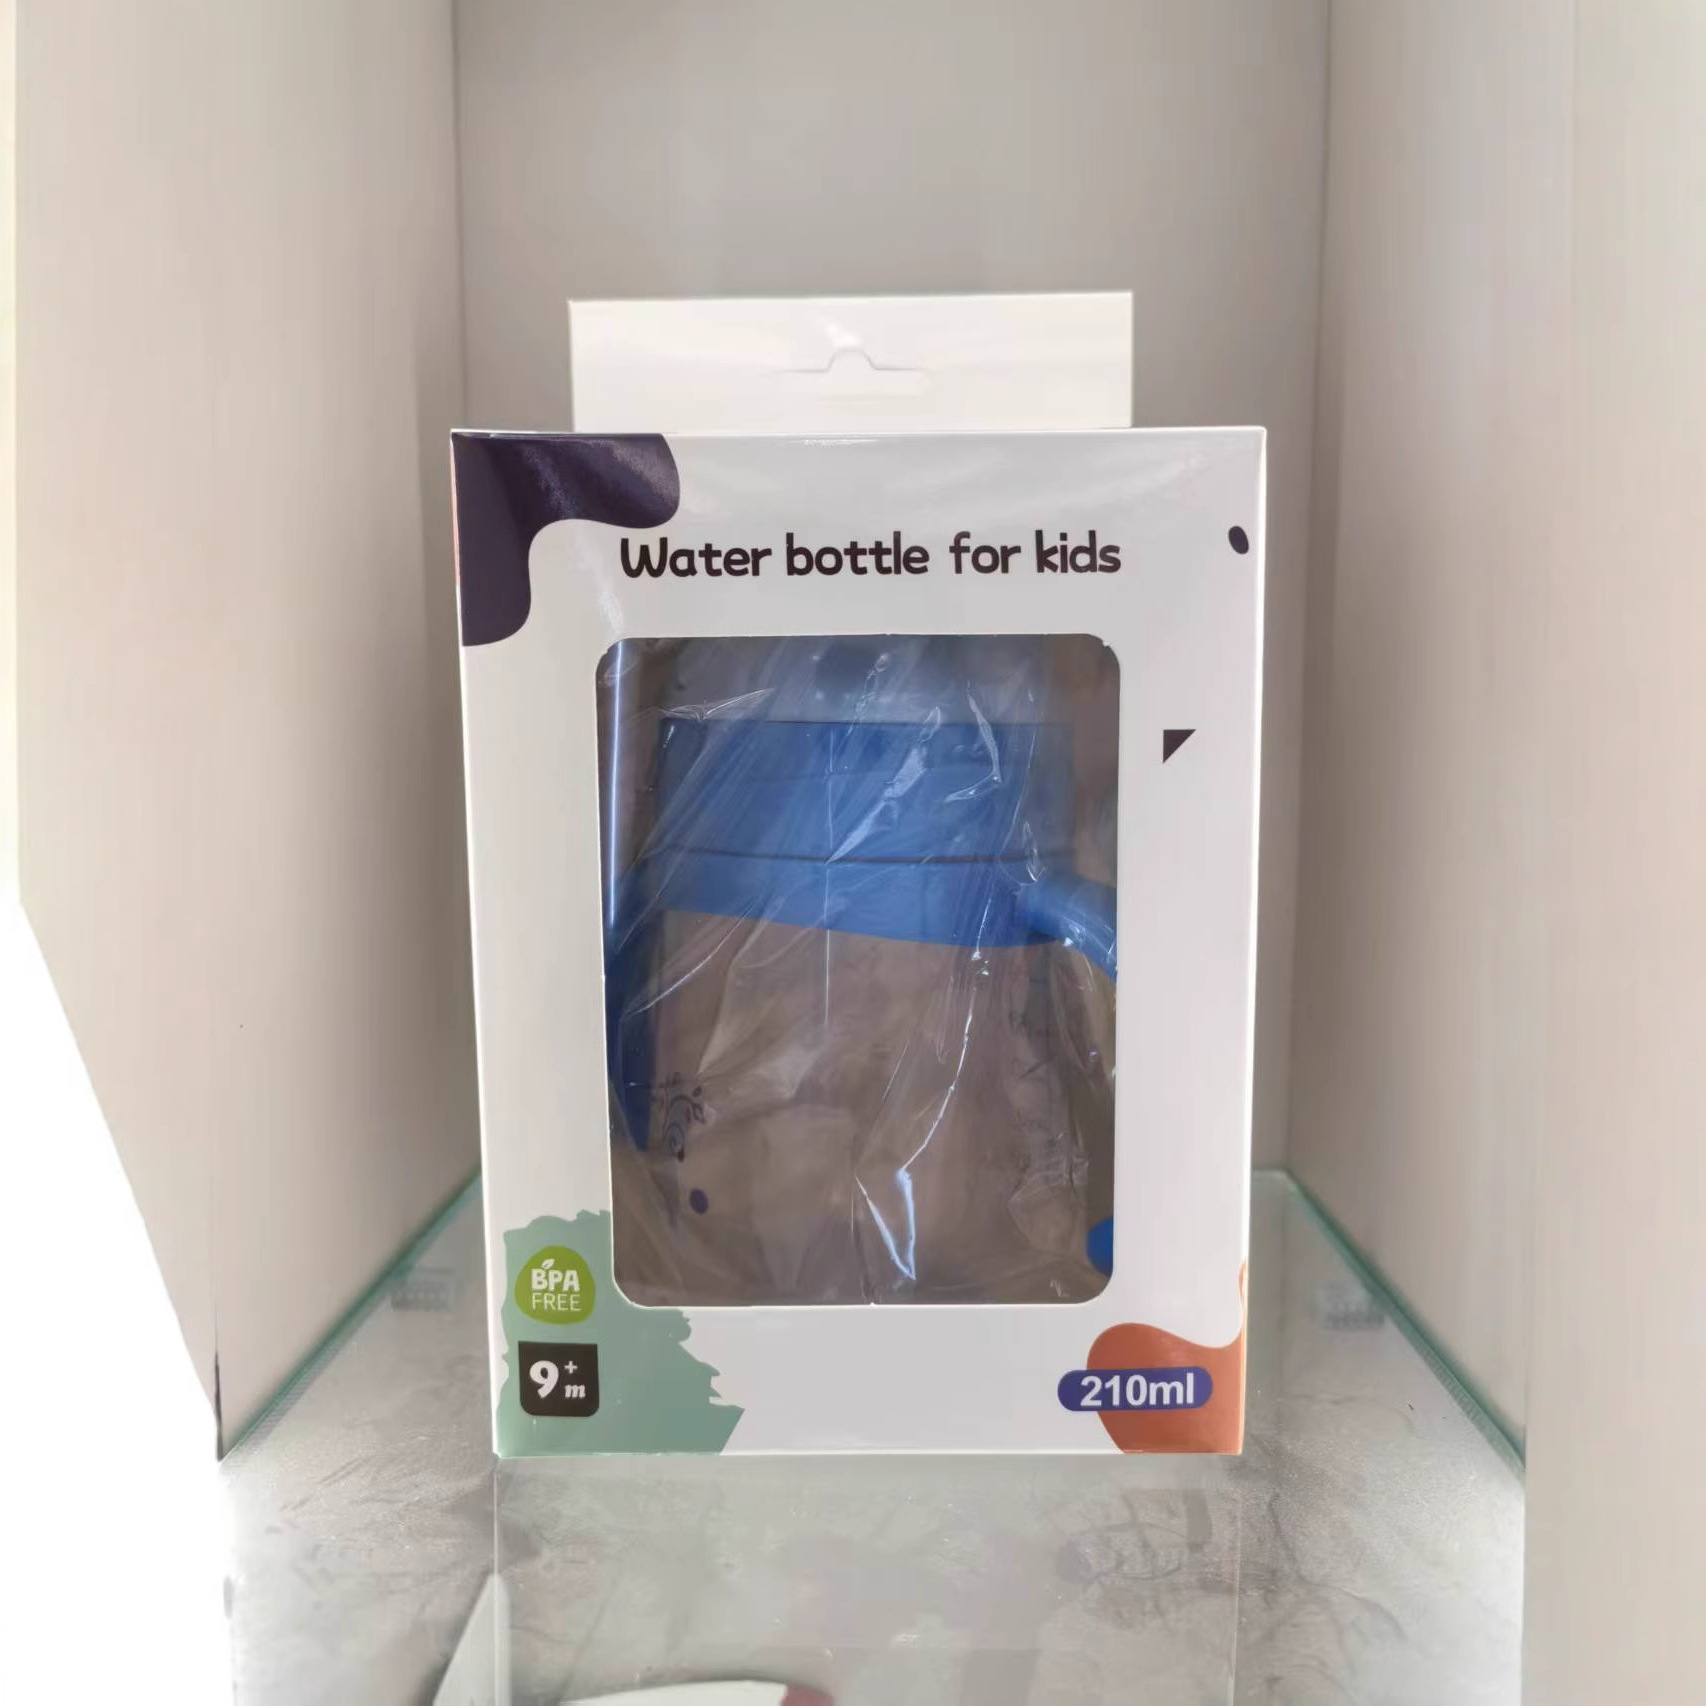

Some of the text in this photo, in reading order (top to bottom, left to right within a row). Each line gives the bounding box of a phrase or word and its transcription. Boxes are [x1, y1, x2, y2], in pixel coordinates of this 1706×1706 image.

[620, 529, 1122, 579] Water bottle for kids
[531, 1267, 580, 1292] BPA
[531, 1292, 581, 1312] FREE
[1080, 1373, 1194, 1407] 210ml
